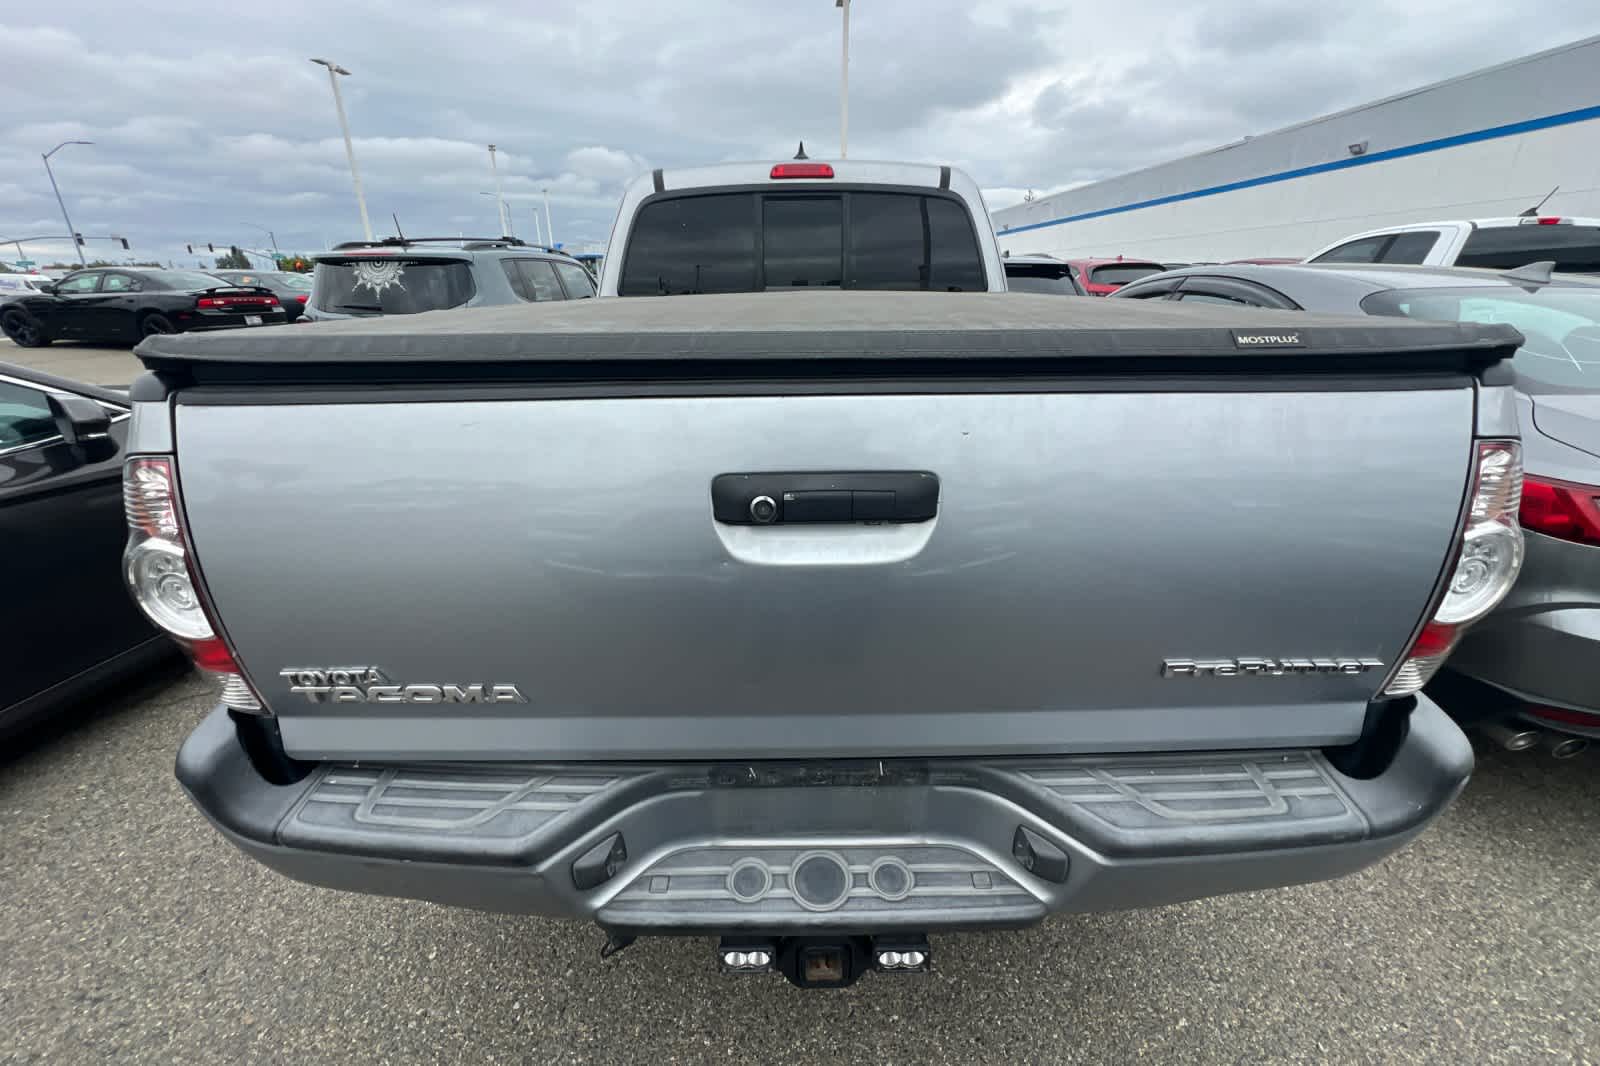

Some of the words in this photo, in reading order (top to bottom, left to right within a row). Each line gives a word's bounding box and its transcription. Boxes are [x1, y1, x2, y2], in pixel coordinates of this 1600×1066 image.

[1237, 335, 1299, 344] MOSTPLUS
[280, 667, 389, 686] TOYOTA
[290, 684, 527, 703] TACOMA
